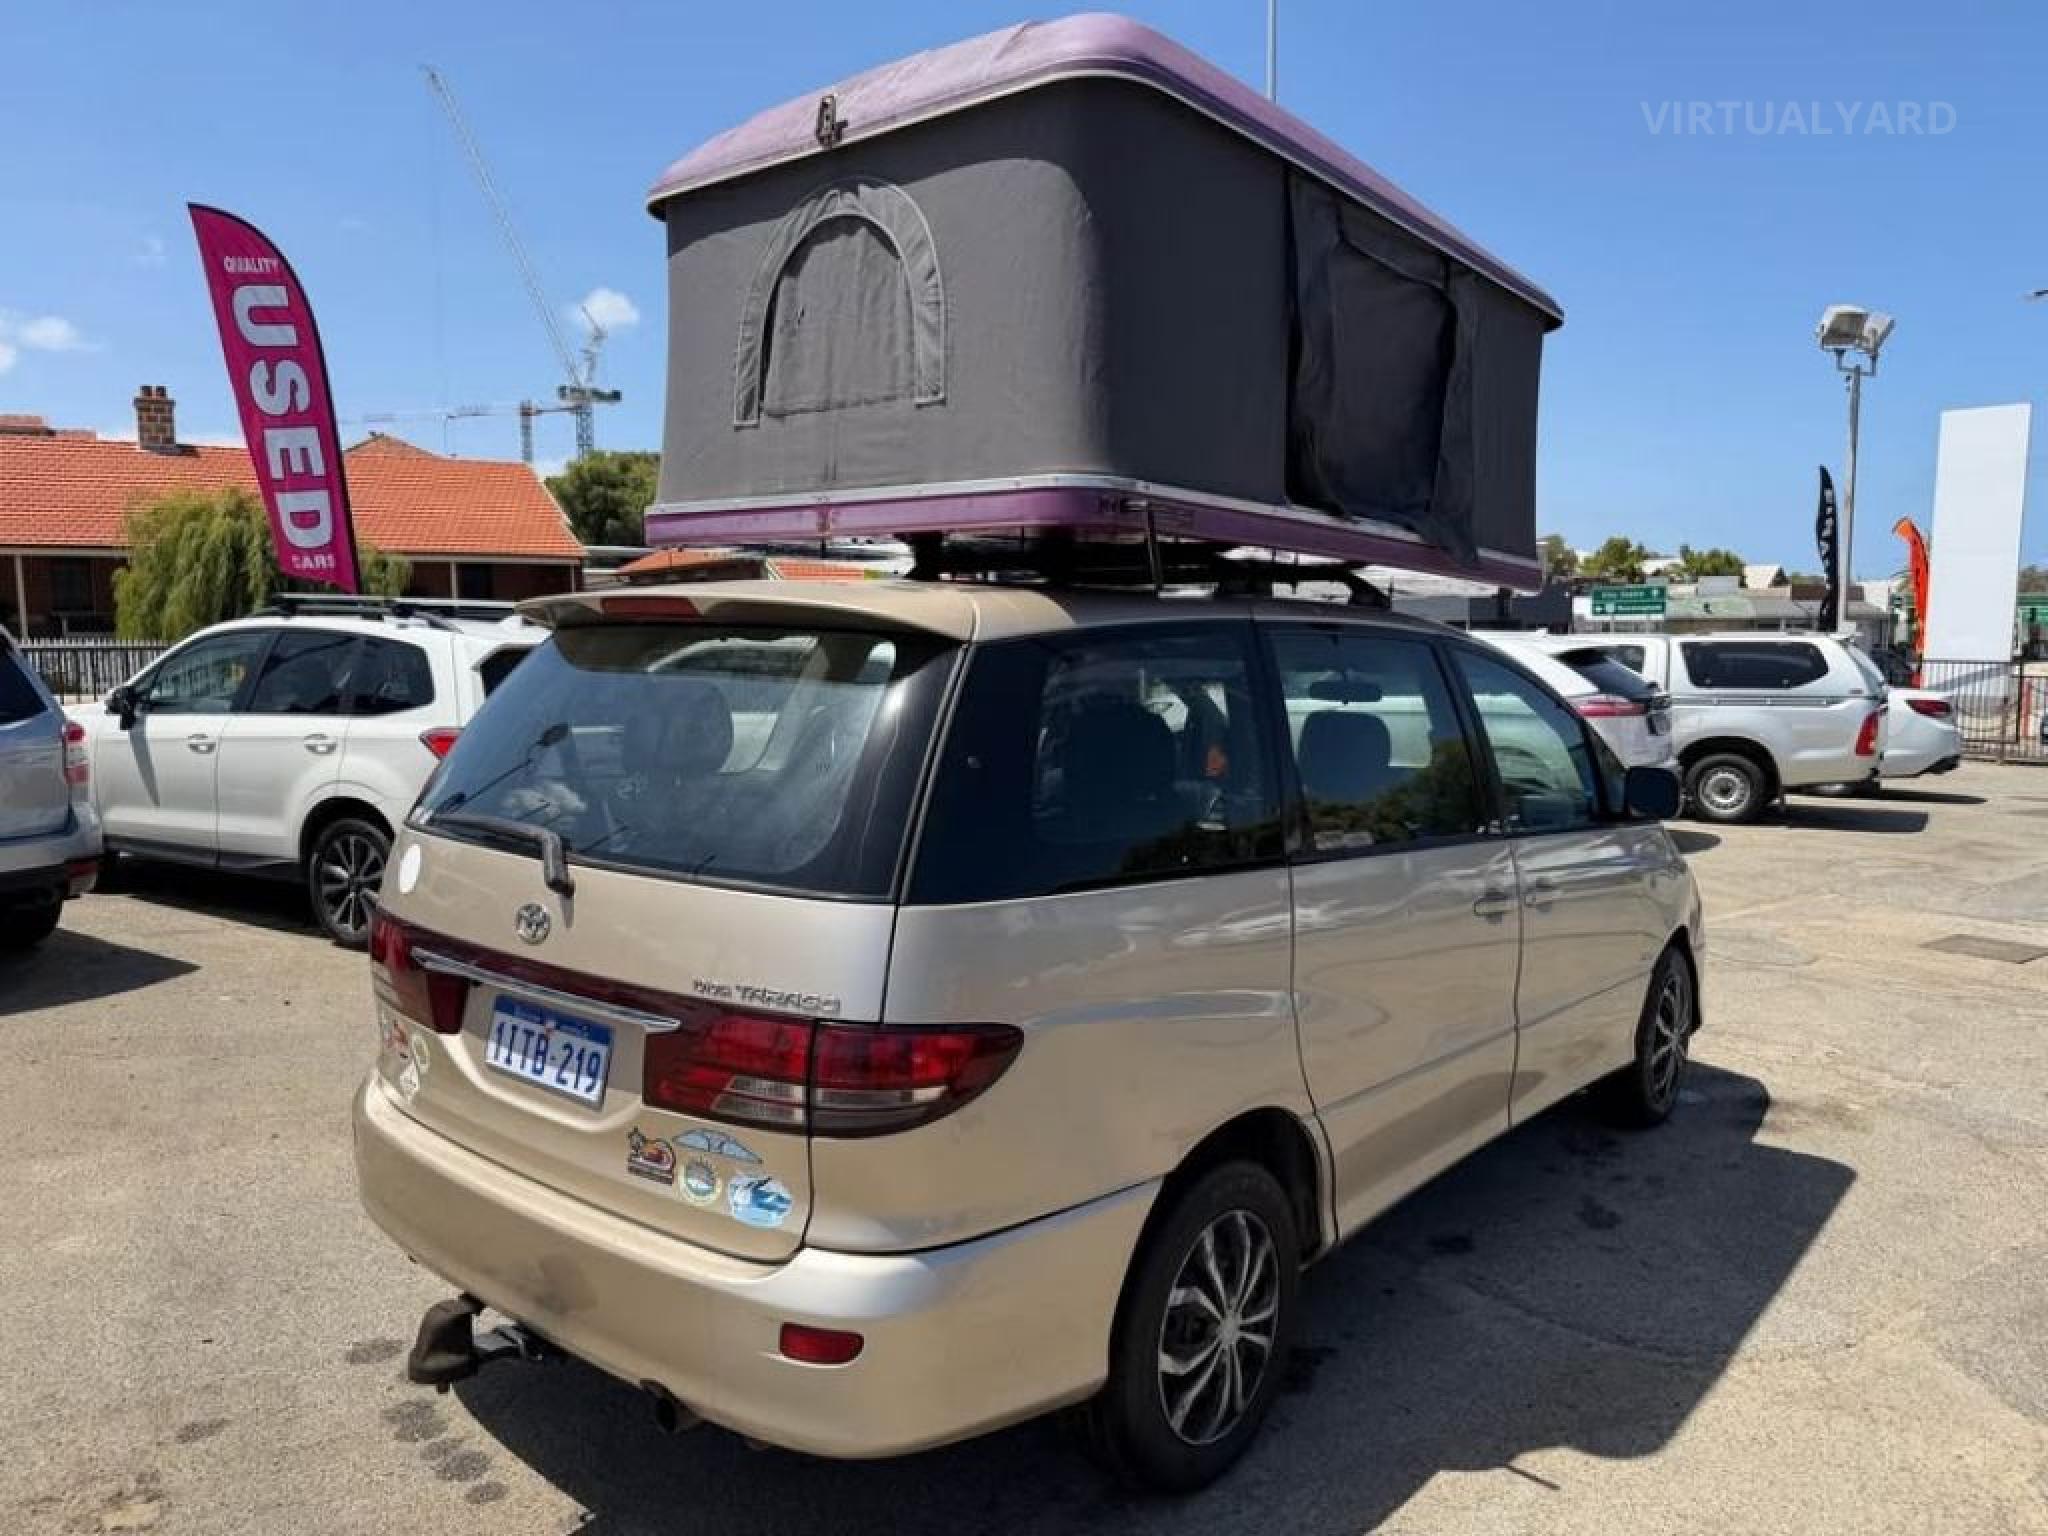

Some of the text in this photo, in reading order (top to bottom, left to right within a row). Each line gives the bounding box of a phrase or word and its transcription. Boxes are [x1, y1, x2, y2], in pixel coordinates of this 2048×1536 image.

[223, 255, 281, 273] QUALITY
[231, 285, 334, 549] USED
[290, 553, 337, 569] CARS
